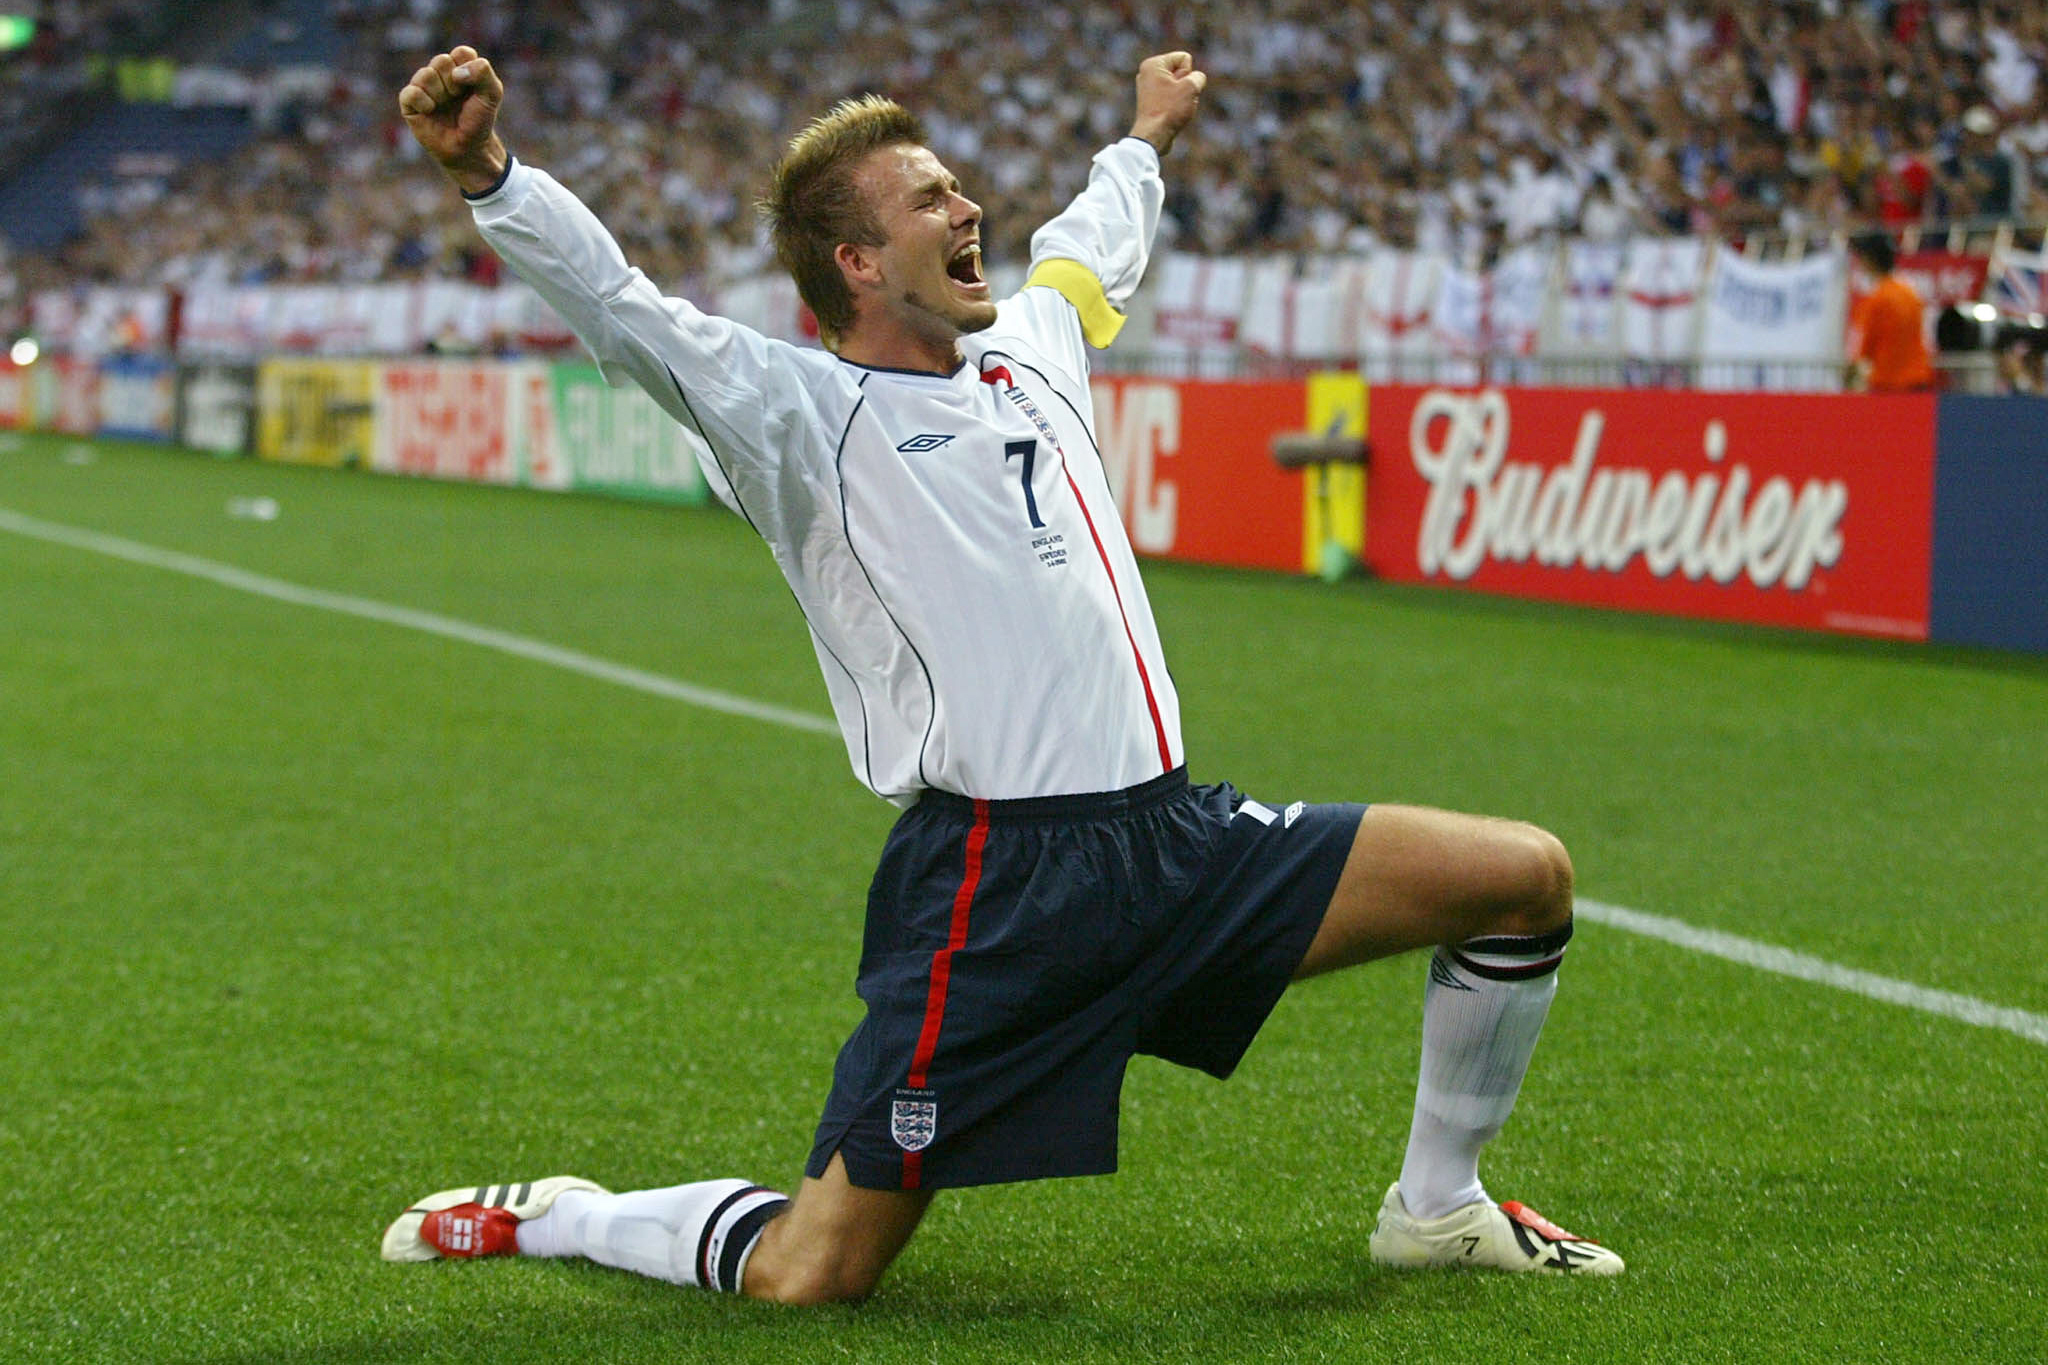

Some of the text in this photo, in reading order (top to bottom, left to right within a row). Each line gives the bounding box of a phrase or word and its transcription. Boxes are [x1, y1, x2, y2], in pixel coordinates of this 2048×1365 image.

[1091, 384, 1181, 553] VC
[1004, 440, 1046, 528] 7
[1410, 389, 1848, 591] Budweiser
[1032, 534, 1064, 549] ENGLAND
[1038, 549, 1067, 561] SWEDEN
[896, 1087, 935, 1096] ENGLAND
[1462, 1237, 1480, 1255] 7
